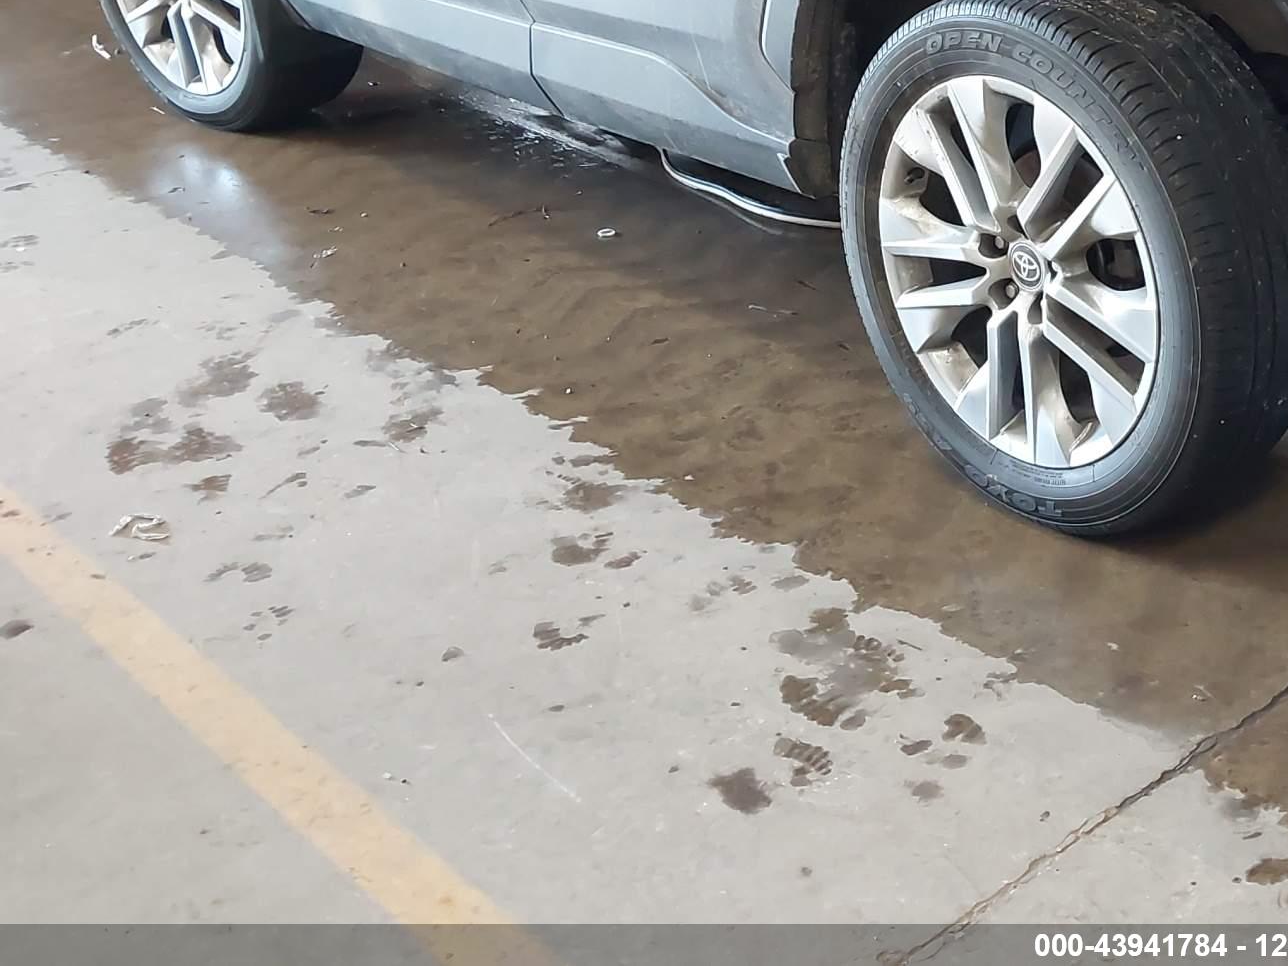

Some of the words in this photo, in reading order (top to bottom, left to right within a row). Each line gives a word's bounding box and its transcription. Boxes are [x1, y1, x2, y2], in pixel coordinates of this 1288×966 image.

[925, 31, 1002, 56] OPEN
[1011, 43, 1147, 172] COUNTRY
[962, 464, 1063, 518] TOYO
